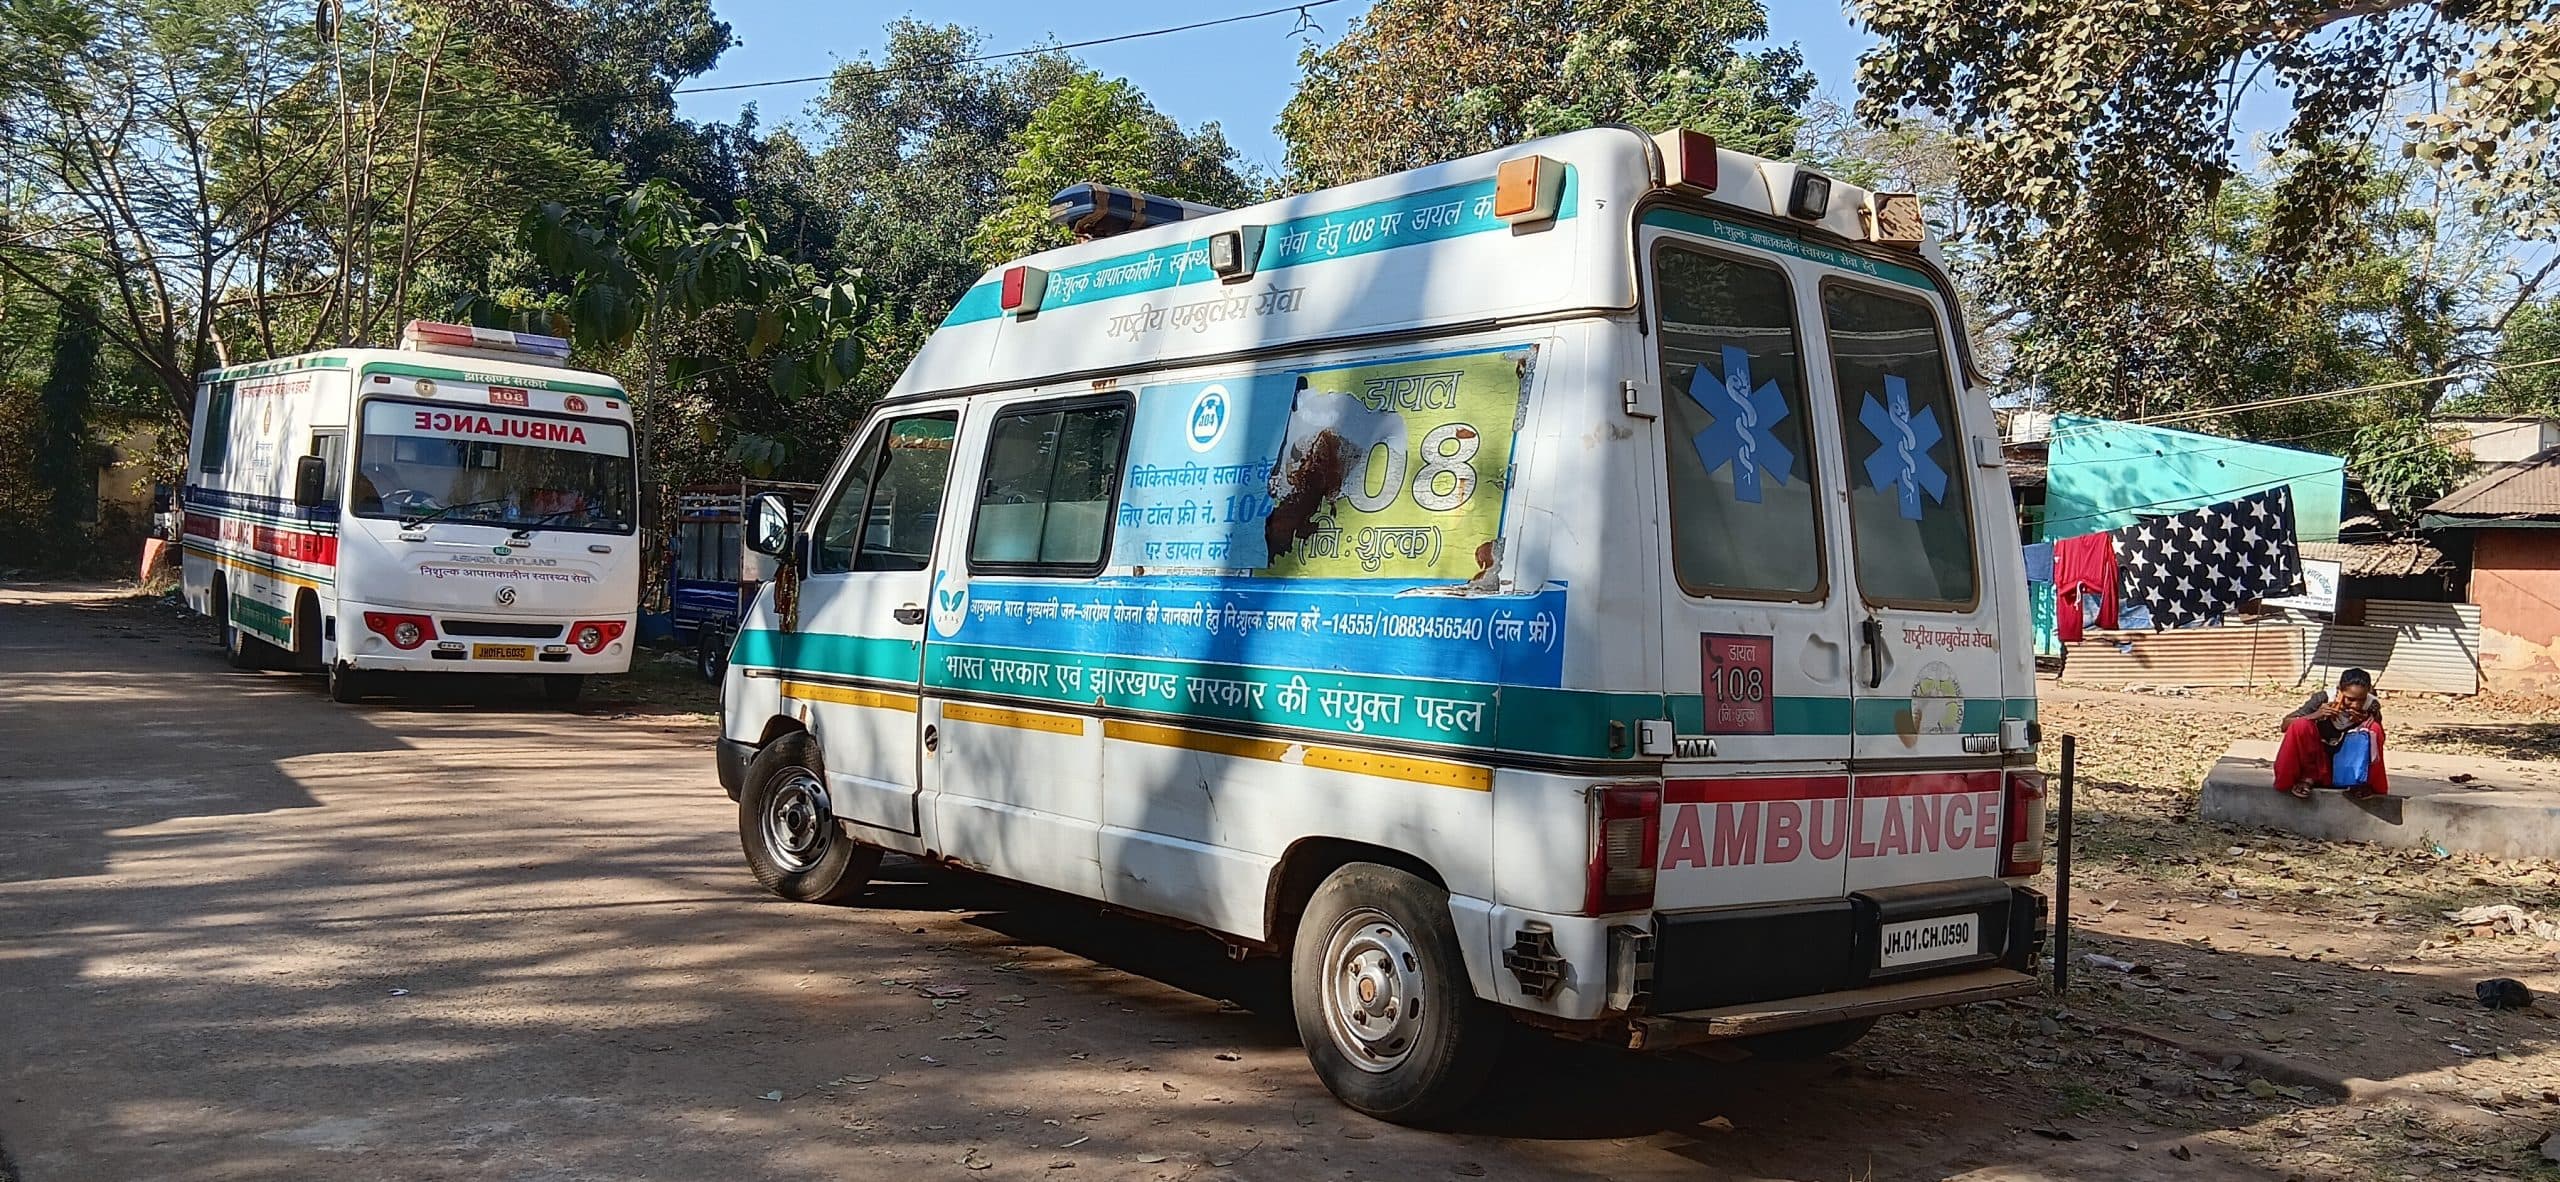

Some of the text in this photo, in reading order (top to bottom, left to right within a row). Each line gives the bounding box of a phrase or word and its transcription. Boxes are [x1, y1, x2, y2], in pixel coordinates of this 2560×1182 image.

[1093, 253, 1164, 288] आपातकालीन
[1280, 227, 1310, 257] सेवा
[1316, 218, 1344, 256] हेतु
[1346, 218, 1373, 244] 108
[1380, 211, 1404, 237] पर
[1412, 199, 1464, 230] डायल
[1750, 232, 1799, 254] आपातकालीन
[1840, 252, 1858, 268] सेवा
[1861, 257, 1877, 275] हेतु
[1106, 283, 1305, 342] राष्ट्रीय एम्बुलेंस सेवा
[464, 372, 548, 389] झारखण्ड सरकार
[1362, 371, 1464, 413] डायल
[493, 391, 524, 402] 108
[1199, 414, 1215, 427] 104
[1130, 461, 1209, 489] चिकित्सकीय
[1213, 462, 1252, 487] सलाह
[1335, 423, 1480, 513] 08
[1118, 503, 1143, 528] लिए
[1147, 503, 1173, 526] टॉल
[1176, 501, 1197, 526] फ्री
[450, 554, 496, 565] ASHOK
[1146, 533, 1234, 561] पर डायल करें
[420, 565, 459, 579] निशुल्क
[463, 567, 530, 580] आपातकालीन
[572, 573, 591, 584] सेवा
[1004, 600, 1025, 617] भारत
[1113, 600, 1143, 624] योजना
[1145, 600, 1159, 625] की
[1161, 600, 1203, 627] जानकारी
[1205, 603, 1221, 636] हेतु
[1265, 610, 1298, 632] डायल
[1301, 605, 1321, 632] करें
[1488, 609, 1524, 649] (टॉल
[1528, 611, 1557, 653] फ्री)
[1902, 625, 1992, 652] राष्ट्रीय एम्बुलेंस सेवा
[1728, 644, 1757, 661] डायल
[945, 655, 1486, 733] भारत सरकार एवं झारखण्ड सरकार की संयुक्त पहल
[1711, 666, 1763, 703] 108
[1677, 739, 1718, 757] TATA
[1660, 792, 2000, 870] AMBULANCE
[1884, 922, 1969, 955] JH.01.CH.0590
